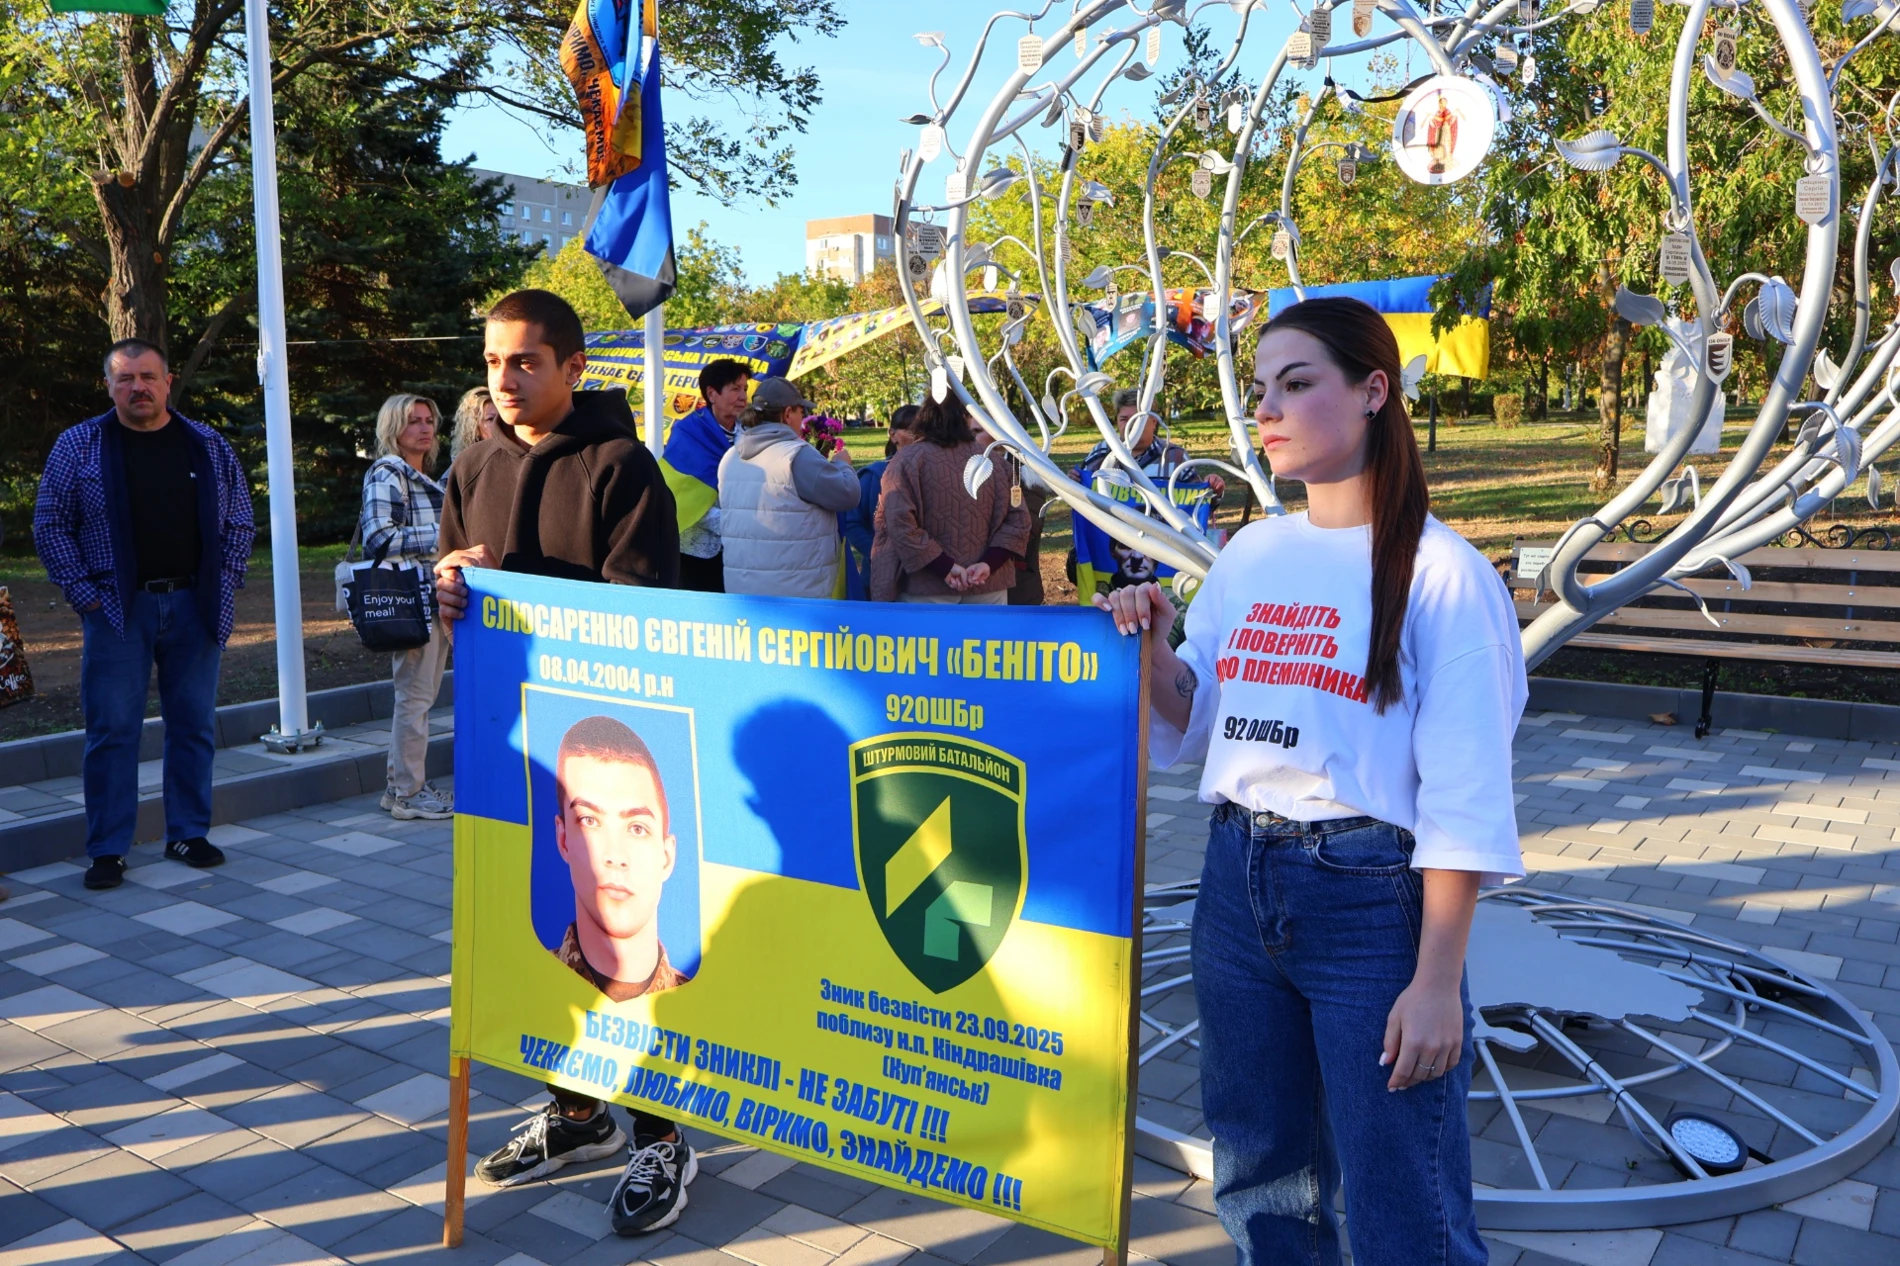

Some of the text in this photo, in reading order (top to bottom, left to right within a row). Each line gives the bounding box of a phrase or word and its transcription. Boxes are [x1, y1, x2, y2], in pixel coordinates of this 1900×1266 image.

[363, 594, 416, 608] Enjoy your
[365, 607, 395, 618] meal!
[1246, 602, 1341, 631] ЗНАЙДІТЬ
[482, 596, 639, 650] СЛЮСАРЕНКО
[645, 618, 751, 662] ЄВГЕНІЙ
[758, 625, 938, 676] СЕРГІЙОВИЧ
[946, 639, 1098, 684] «БЕНІТО»
[1236, 628, 1339, 659] ПОВЕРНІТЬ
[539, 654, 674, 698] 08.04.2004 р.н
[1242, 659, 1368, 704] ПЛЕМІННИКА
[863, 742, 1011, 783] ШТУРМОВИЙ БАТАЛЬЙОН
[820, 978, 1064, 1056] Зник безвісти 23.09.2025
[816, 1011, 1062, 1091] поблизу н.п. Кіндрашівка
[585, 1009, 691, 1065] БЕЗВІСТИ
[695, 1039, 781, 1092] ЗНИКЛІ
[798, 1068, 829, 1107] НЕ
[831, 1078, 919, 1135] ЗАБУТІ
[919, 1105, 950, 1144] !!!
[519, 1033, 1023, 1212] ЧЕКАЄМО, ЛЮБИМО, ВІРИМО, ЗНАЙДЕМО !!!
